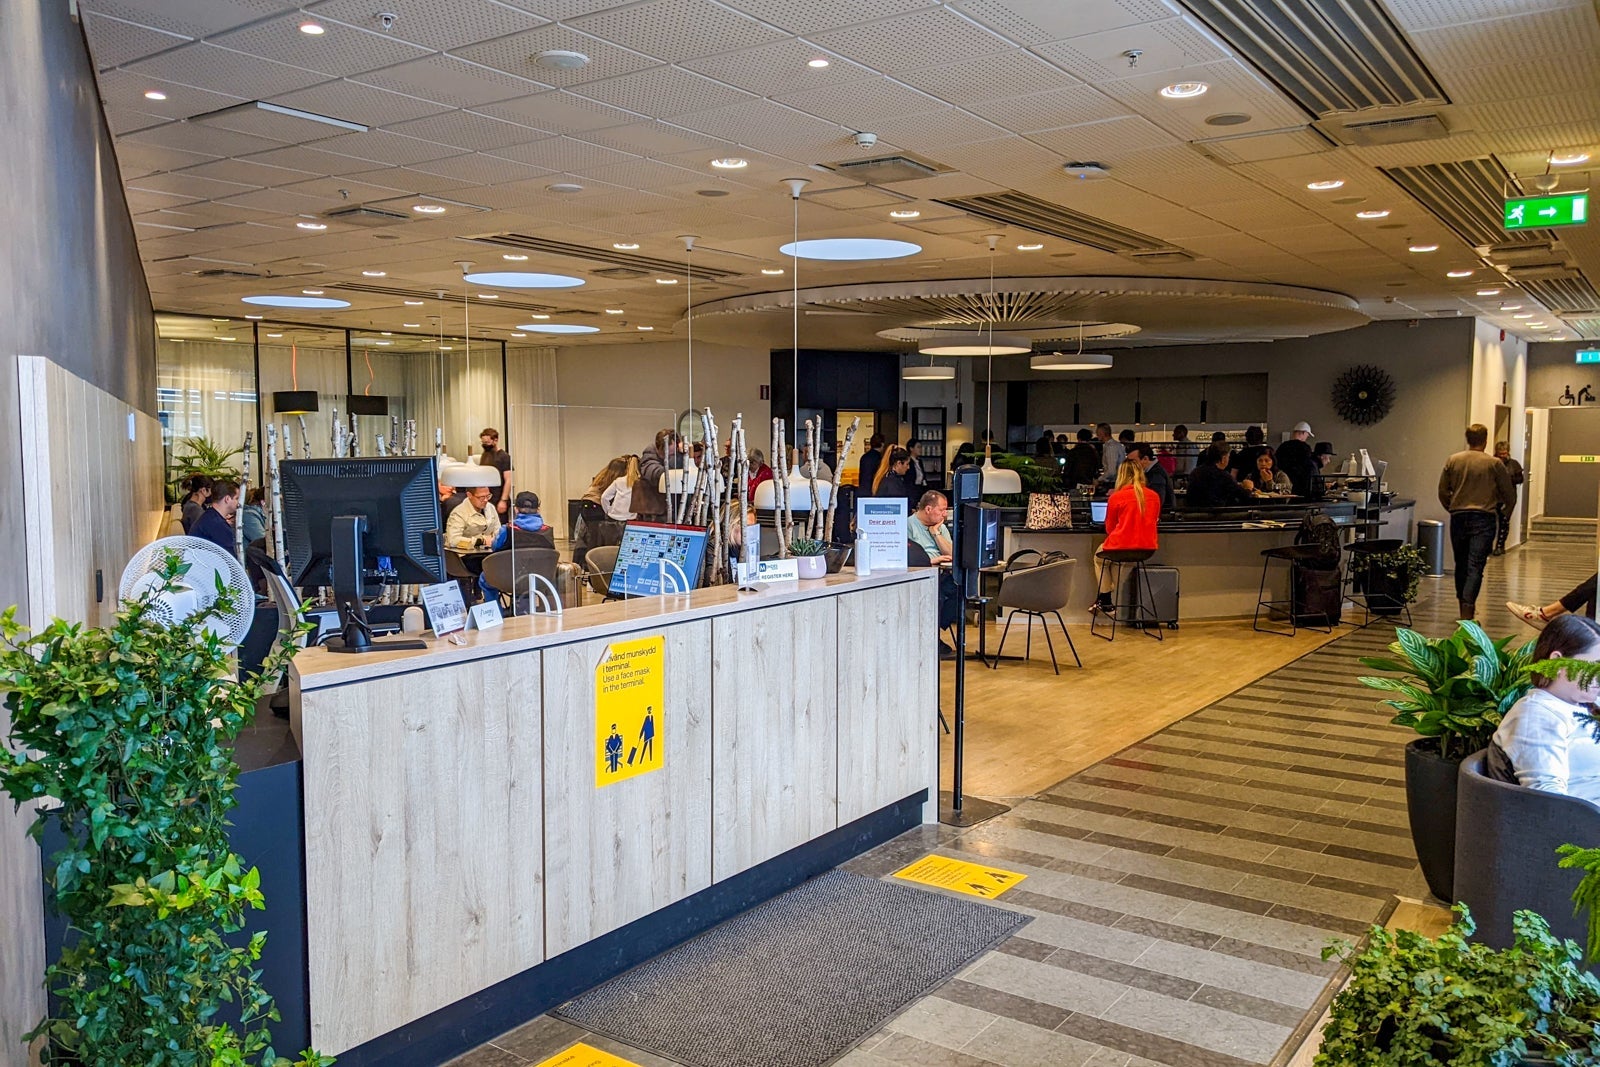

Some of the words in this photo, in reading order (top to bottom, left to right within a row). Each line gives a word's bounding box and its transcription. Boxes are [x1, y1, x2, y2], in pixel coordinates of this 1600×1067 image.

[626, 646, 656, 658] munskydd
[602, 674, 615, 684] Use
[620, 671, 634, 680] face
[634, 666, 650, 676] mask
[603, 684, 609, 693] in
[609, 682, 620, 692] the
